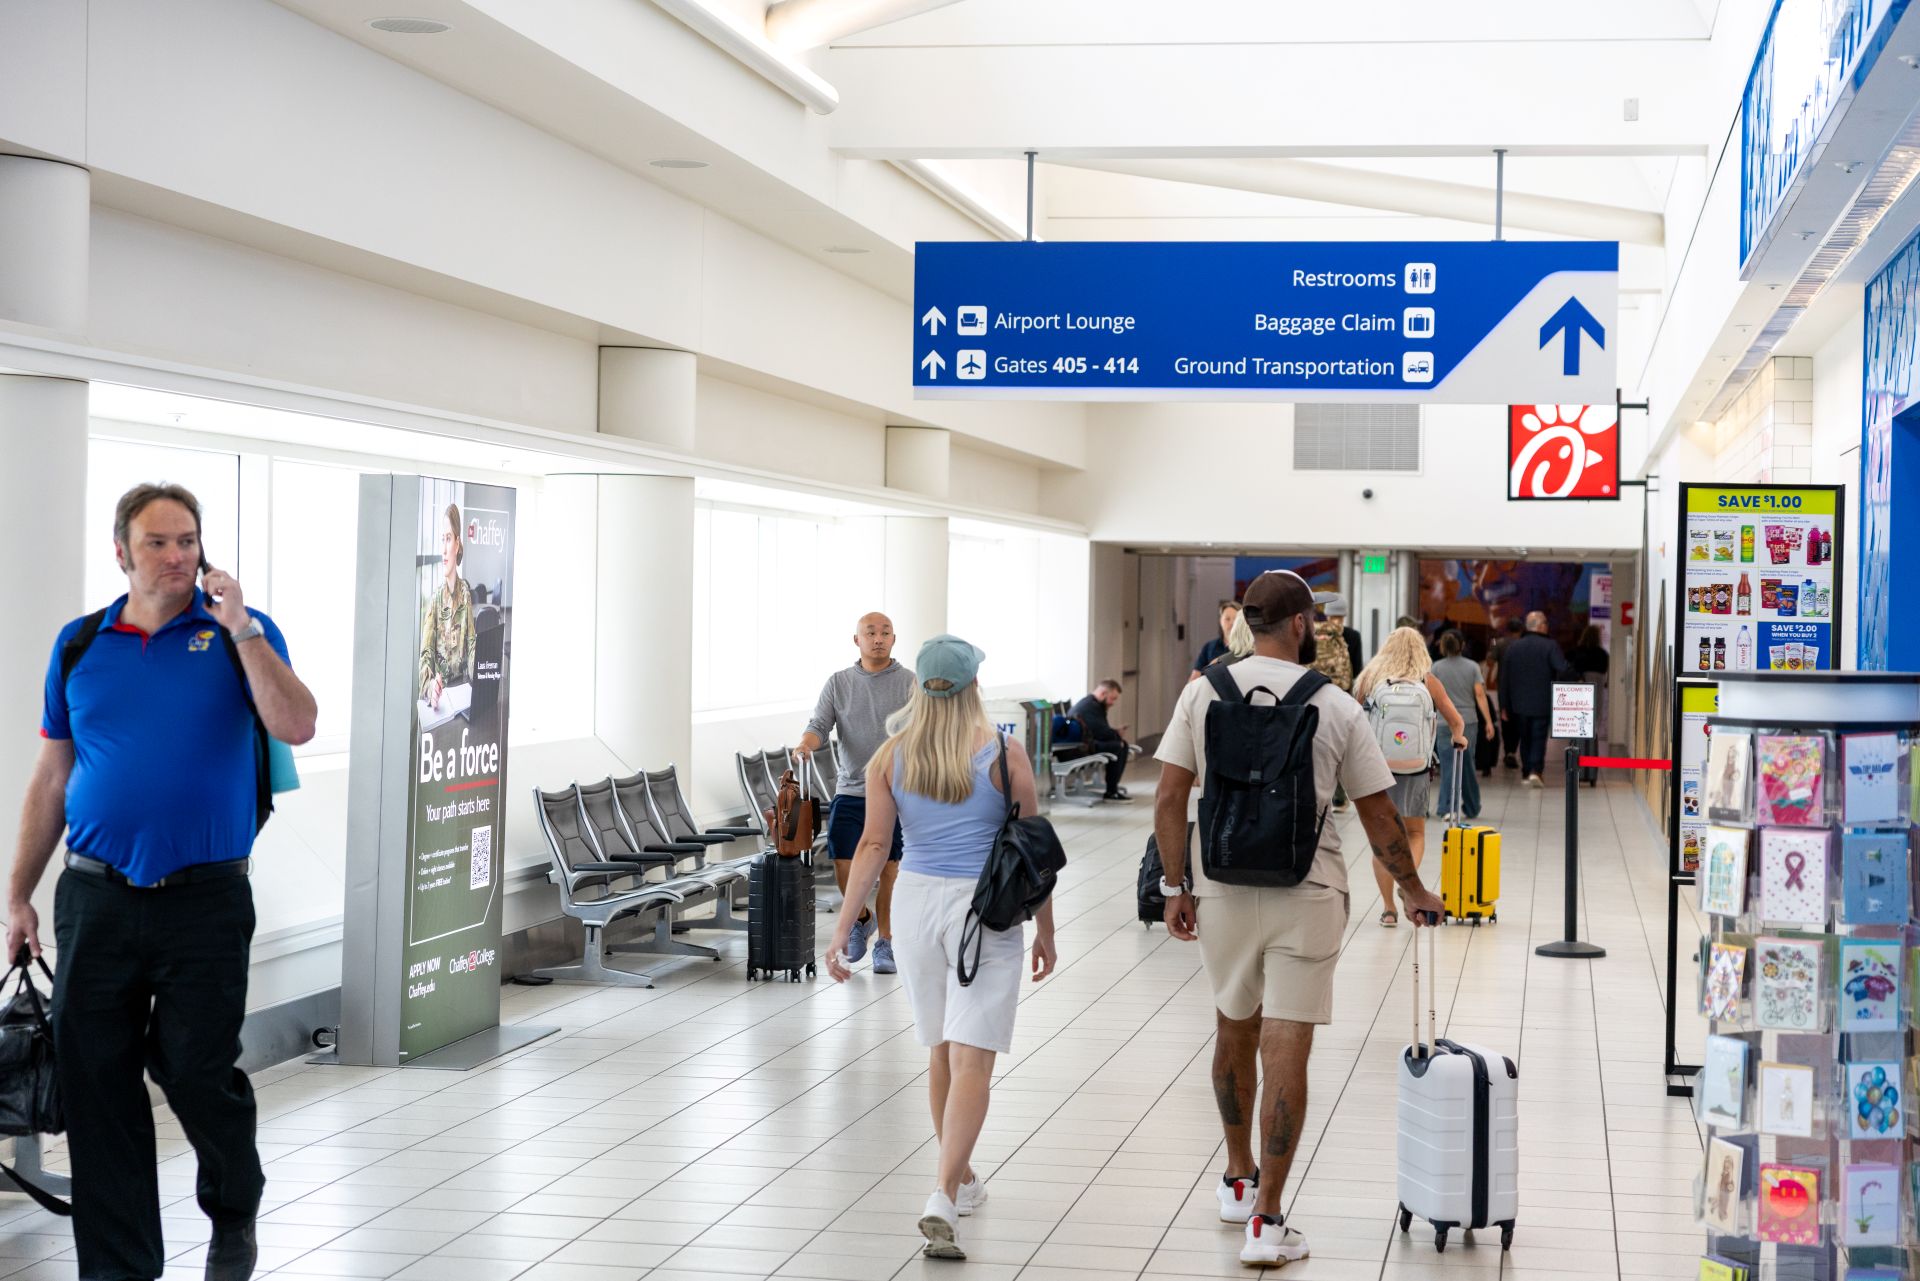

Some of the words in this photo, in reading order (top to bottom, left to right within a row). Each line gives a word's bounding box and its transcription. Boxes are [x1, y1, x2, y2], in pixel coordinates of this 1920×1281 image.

[1292, 269, 1397, 287] Restrooms
[994, 312, 1061, 334] Airport
[1066, 312, 1136, 335] Lounge
[1254, 314, 1336, 336] Baggage
[1341, 313, 1396, 332] Claim
[994, 356, 1048, 374] Gates
[1052, 357, 1087, 374] 405
[1103, 357, 1140, 374] 414
[1174, 357, 1247, 375] Ground
[1251, 357, 1395, 380] Transportation
[1718, 495, 1760, 508] SAVE
[1763, 495, 1802, 508] $1.00
[470, 517, 506, 553] Chaffey
[1364, 556, 1386, 573] EXIT
[420, 732, 443, 784] Be
[446, 748, 456, 780] a
[460, 727, 498, 777] force
[426, 804, 442, 823] Your
[442, 800, 457, 824] path
[458, 798, 475, 817] starts
[476, 795, 490, 813] here
[1221, 815, 1235, 867] Columbia
[409, 961, 427, 979] APPLY
[426, 956, 441, 974] NOW
[449, 955, 470, 974] Chaffey
[476, 948, 495, 966] College
[408, 979, 436, 999] Chaffey.edu
